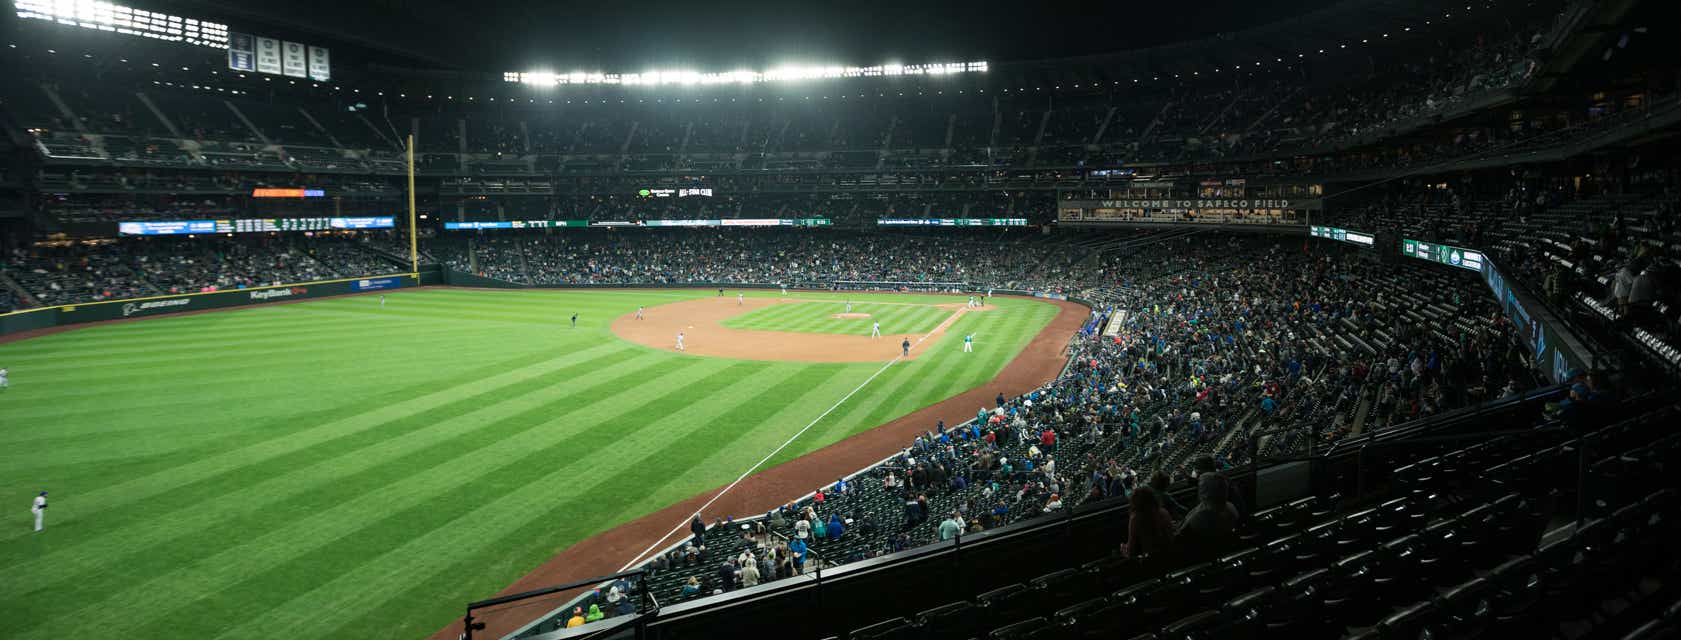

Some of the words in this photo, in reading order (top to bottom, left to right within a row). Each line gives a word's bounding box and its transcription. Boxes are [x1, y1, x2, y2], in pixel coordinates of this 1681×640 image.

[1102, 200, 1169, 208] WELCOME
[1176, 200, 1191, 208] TO
[1197, 200, 1248, 208] SAFECO
[1254, 200, 1289, 208] FIELD
[250, 288, 292, 300] KeyBank
